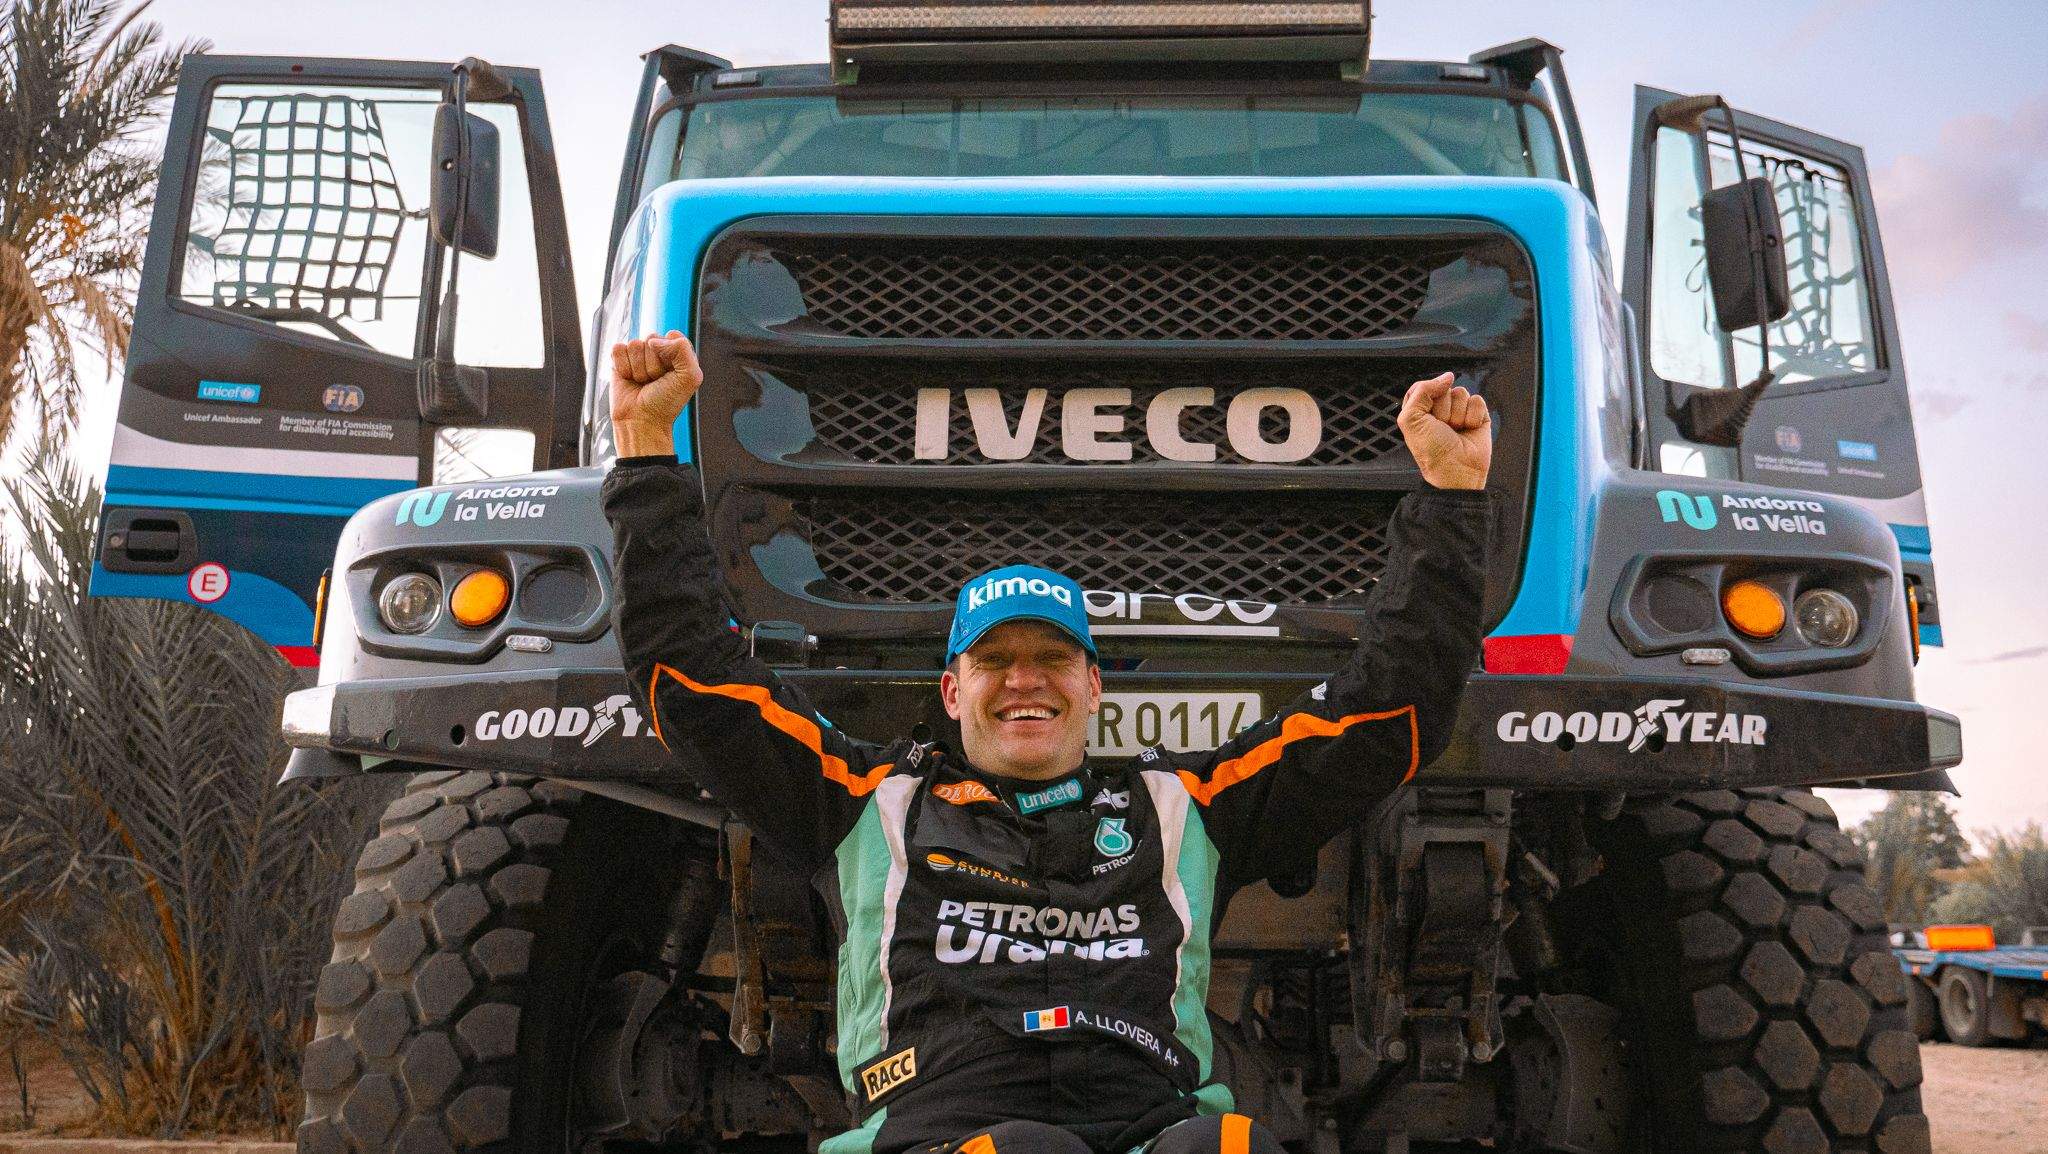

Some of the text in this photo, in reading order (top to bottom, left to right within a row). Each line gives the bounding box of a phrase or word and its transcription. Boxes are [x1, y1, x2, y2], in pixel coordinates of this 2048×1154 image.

[203, 386, 241, 399] unicef
[325, 388, 359, 407] FIA
[184, 413, 263, 425] Unicef Ambassador
[280, 416, 392, 431] Member of FIA Commission
[914, 387, 1322, 463] IVECO
[279, 424, 290, 432] for
[293, 424, 330, 436] disability
[331, 427, 347, 436] and
[455, 485, 560, 500] Andorra
[454, 501, 546, 521] la Vella
[1722, 494, 1824, 513] Andorra
[1731, 513, 1826, 536] la Vella
[201, 573, 217, 593] E
[1082, 590, 1277, 624] arco
[475, 707, 657, 741] GOODY
[1086, 701, 1246, 748] R0114
[1023, 784, 1066, 809] unicef
[937, 899, 1140, 939] PETRONAS
[1075, 1010, 1093, 1025] A.
[1096, 1014, 1160, 1054] LLOVERA
[866, 1053, 913, 1096] RACC
